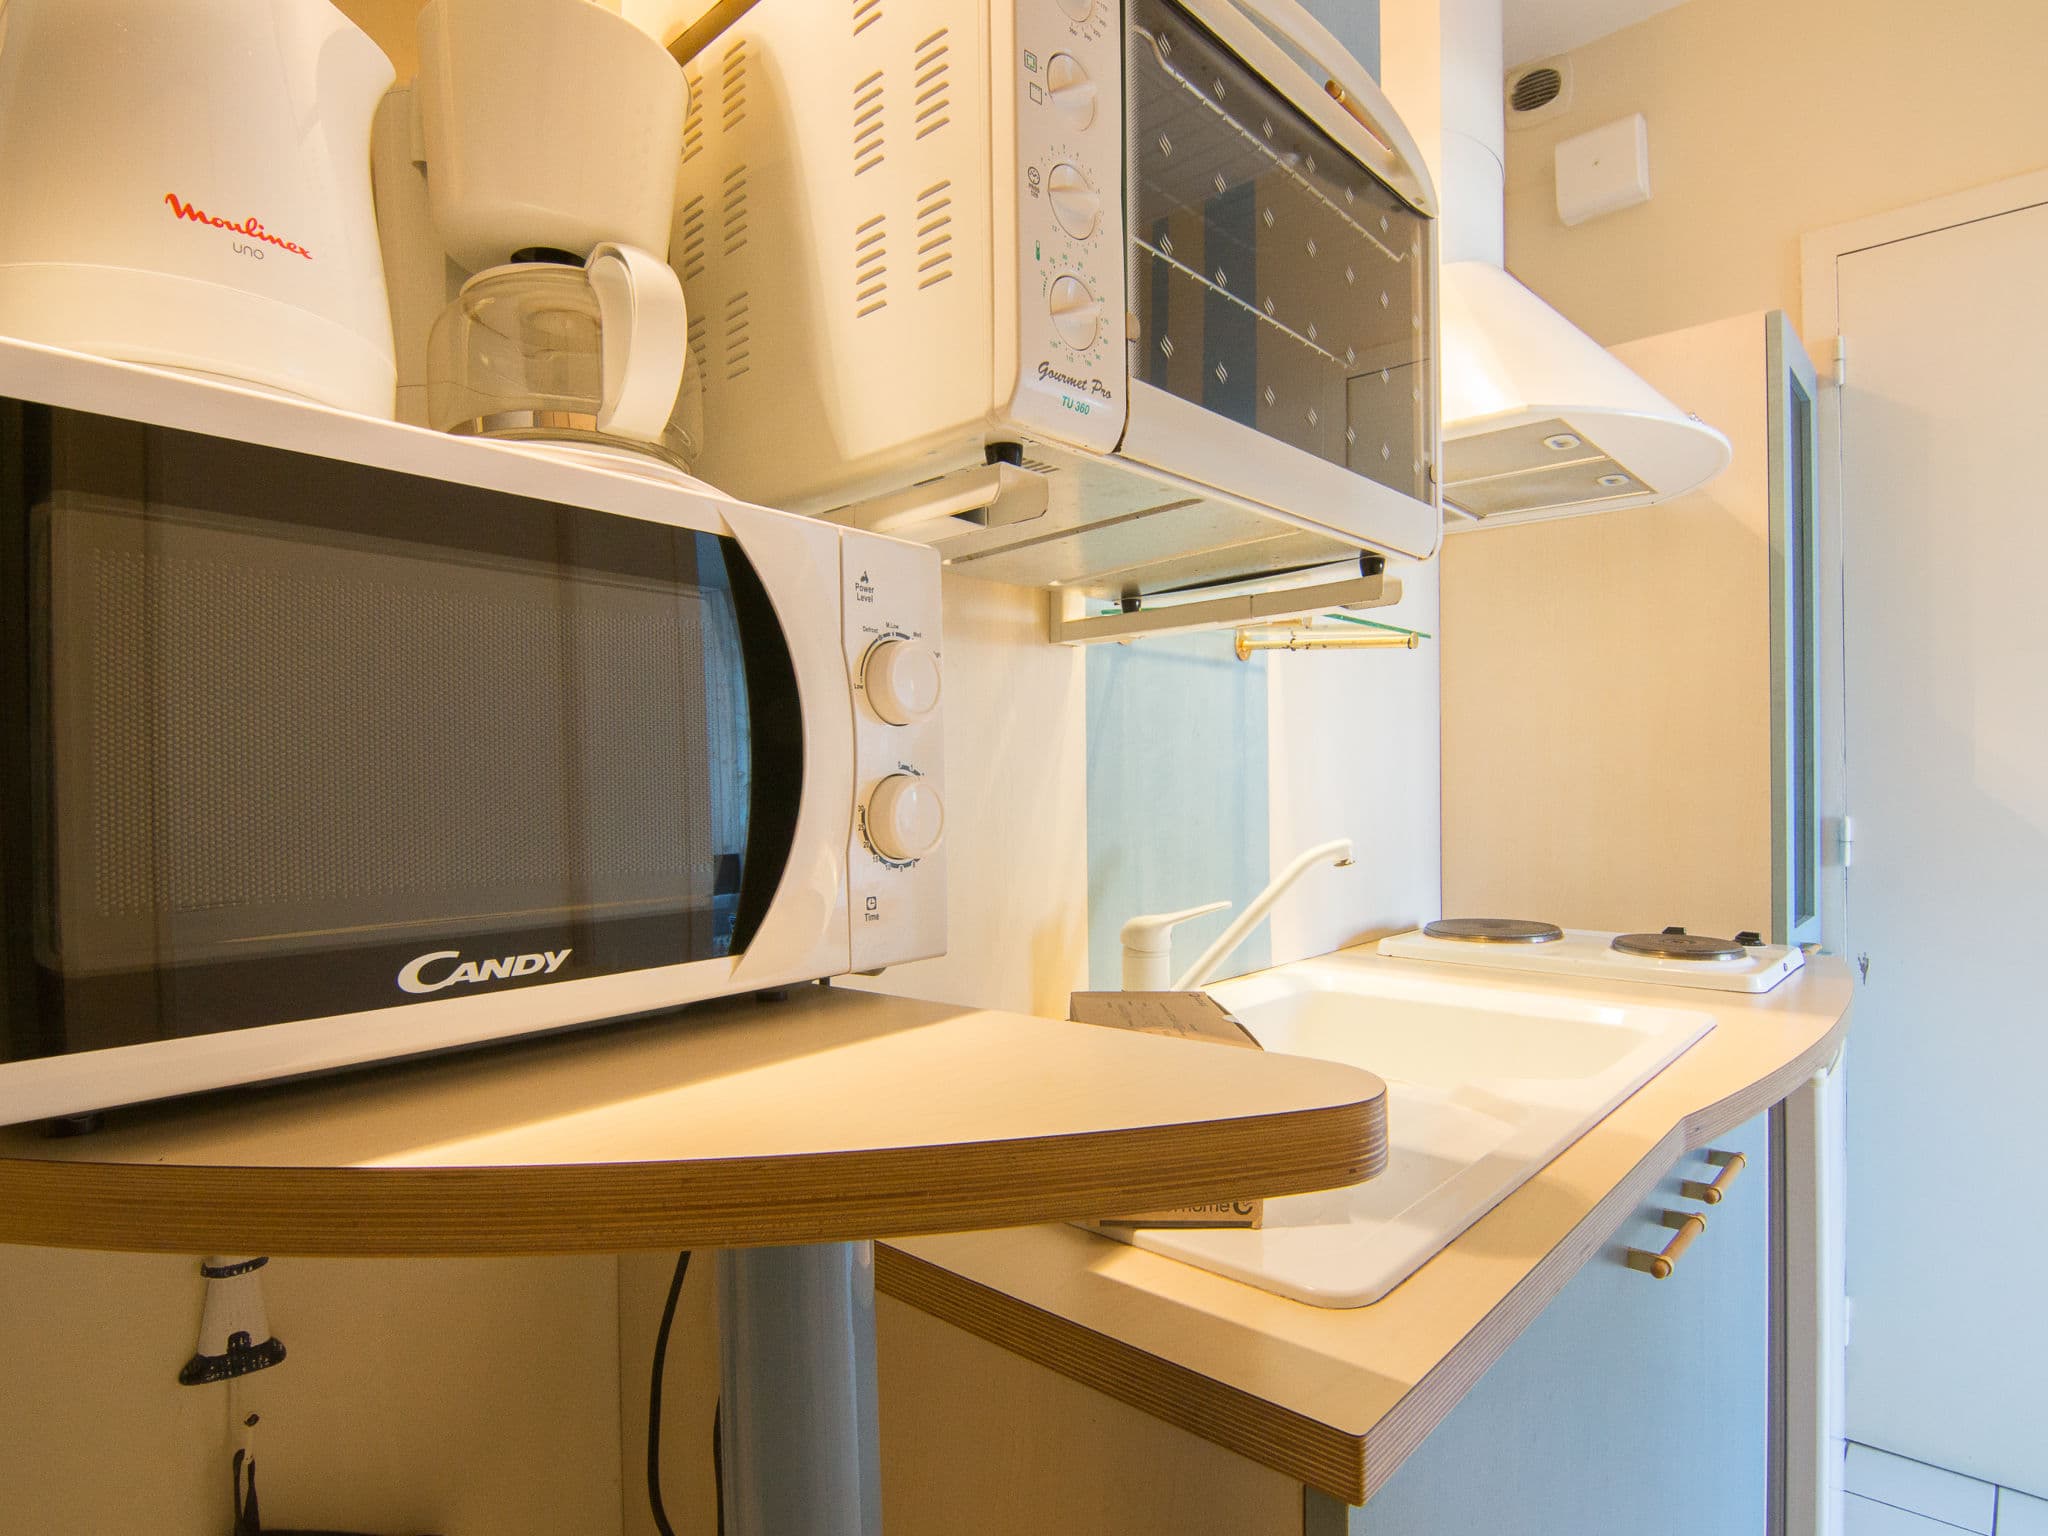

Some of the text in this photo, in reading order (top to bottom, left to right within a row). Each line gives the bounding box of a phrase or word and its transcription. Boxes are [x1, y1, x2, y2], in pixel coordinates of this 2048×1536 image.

[165, 193, 313, 260] Moulinex
[1038, 360, 1112, 399] Gourmet Pro
[1062, 395, 1090, 416] TU 360
[855, 582, 875, 594] Power
[856, 592, 874, 604] Level
[864, 912, 880, 922] Time
[397, 948, 573, 994] CANDY
